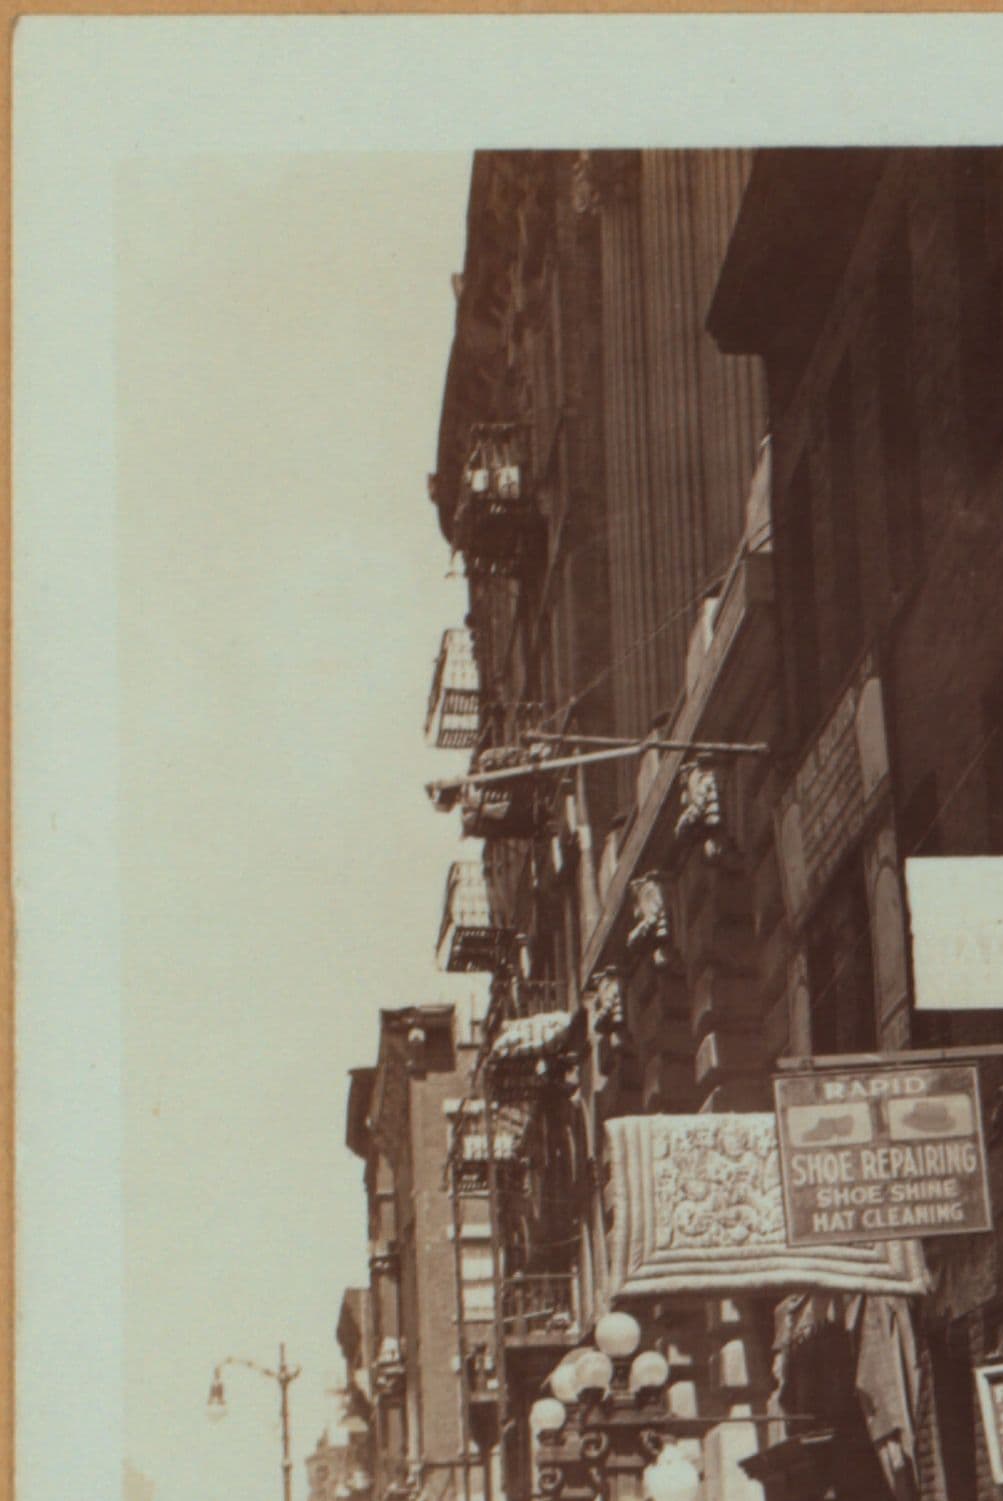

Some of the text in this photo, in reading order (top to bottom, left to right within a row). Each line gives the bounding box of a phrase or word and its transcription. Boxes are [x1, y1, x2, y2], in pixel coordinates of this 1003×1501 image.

[823, 1076, 926, 1099] RAPID
[791, 1142, 977, 1186] SHOE REPAIRING
[816, 1179, 959, 1209] SHOE SHINE
[812, 1202, 964, 1233] HAT CLEANING
